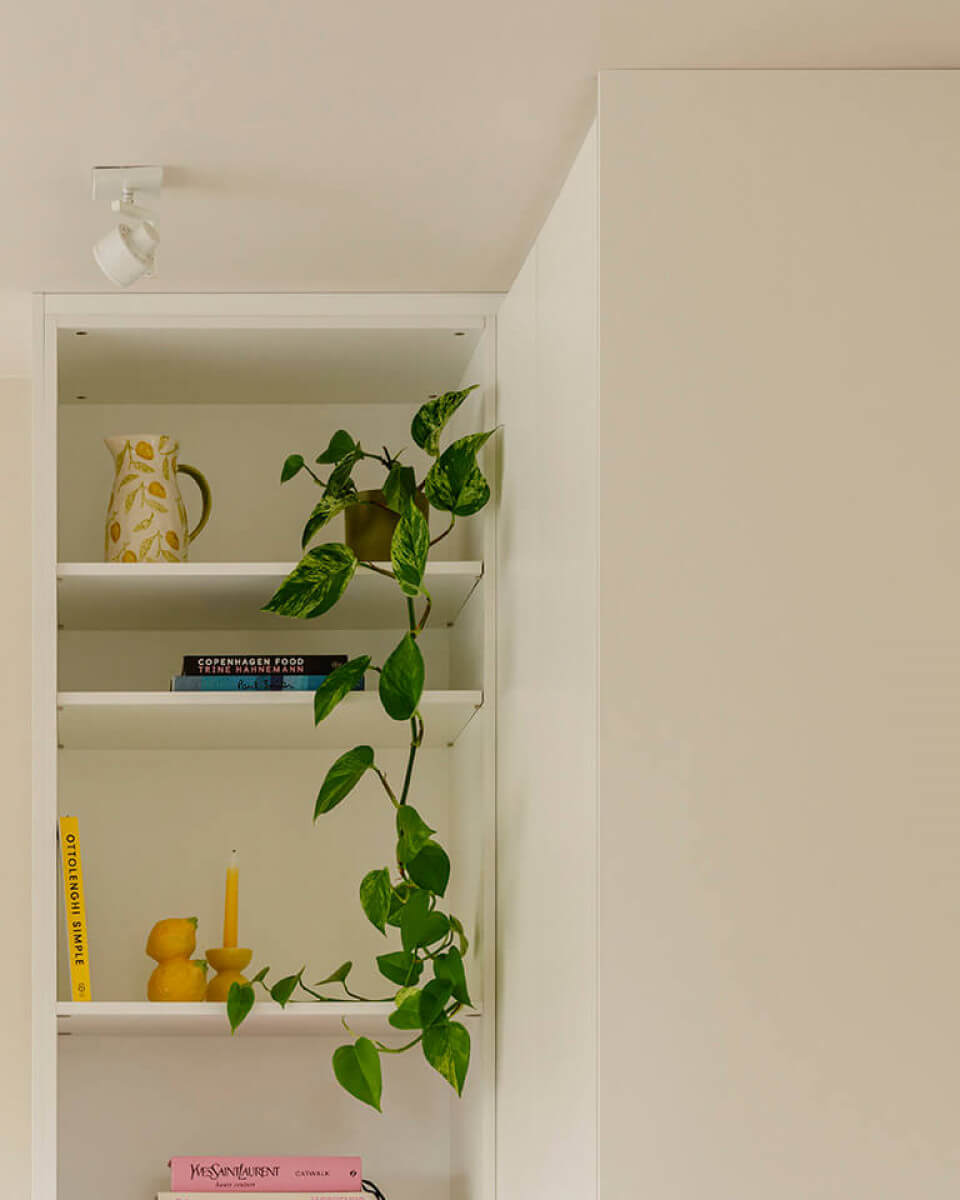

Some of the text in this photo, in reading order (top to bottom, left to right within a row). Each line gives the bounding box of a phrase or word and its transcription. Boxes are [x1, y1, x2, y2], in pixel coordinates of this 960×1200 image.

[197, 658, 271, 666] COPENHAGEN
[198, 666, 231, 674] TRINE
[65, 834, 85, 966] OTTOLENGHI SIMPLE
